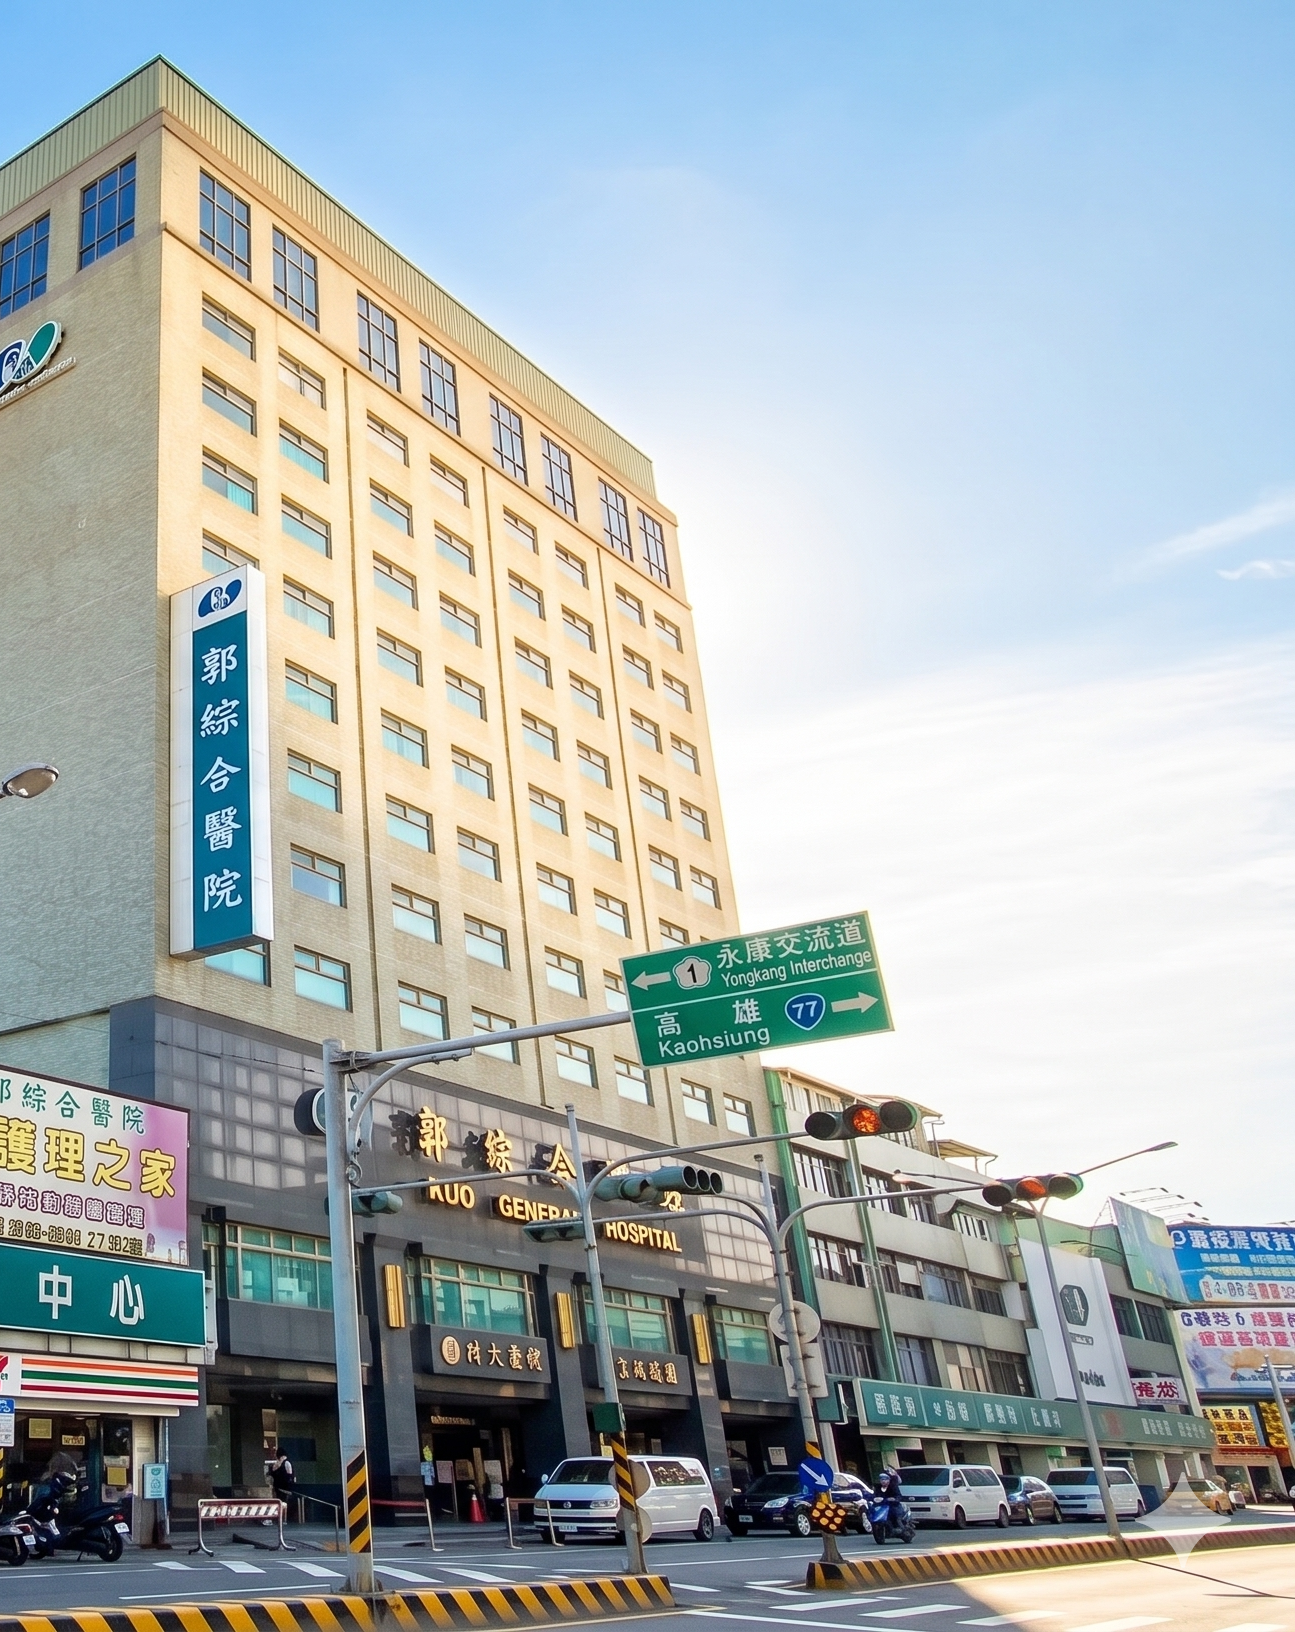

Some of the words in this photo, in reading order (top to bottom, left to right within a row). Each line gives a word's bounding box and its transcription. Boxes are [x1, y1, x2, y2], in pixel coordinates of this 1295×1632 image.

[199, 643, 243, 913] 郭綜合醫院
[716, 919, 866, 970] 永康交流道
[686, 963, 698, 984] 1
[721, 963, 787, 988] Yongkang
[790, 949, 873, 974] Interchange
[654, 998, 762, 1038] 高雄
[792, 1000, 818, 1020] 77
[658, 1027, 771, 1058] Kaohsiung
[428, 1177, 475, 1209] KUO
[605, 1221, 683, 1253] HOSPITAL
